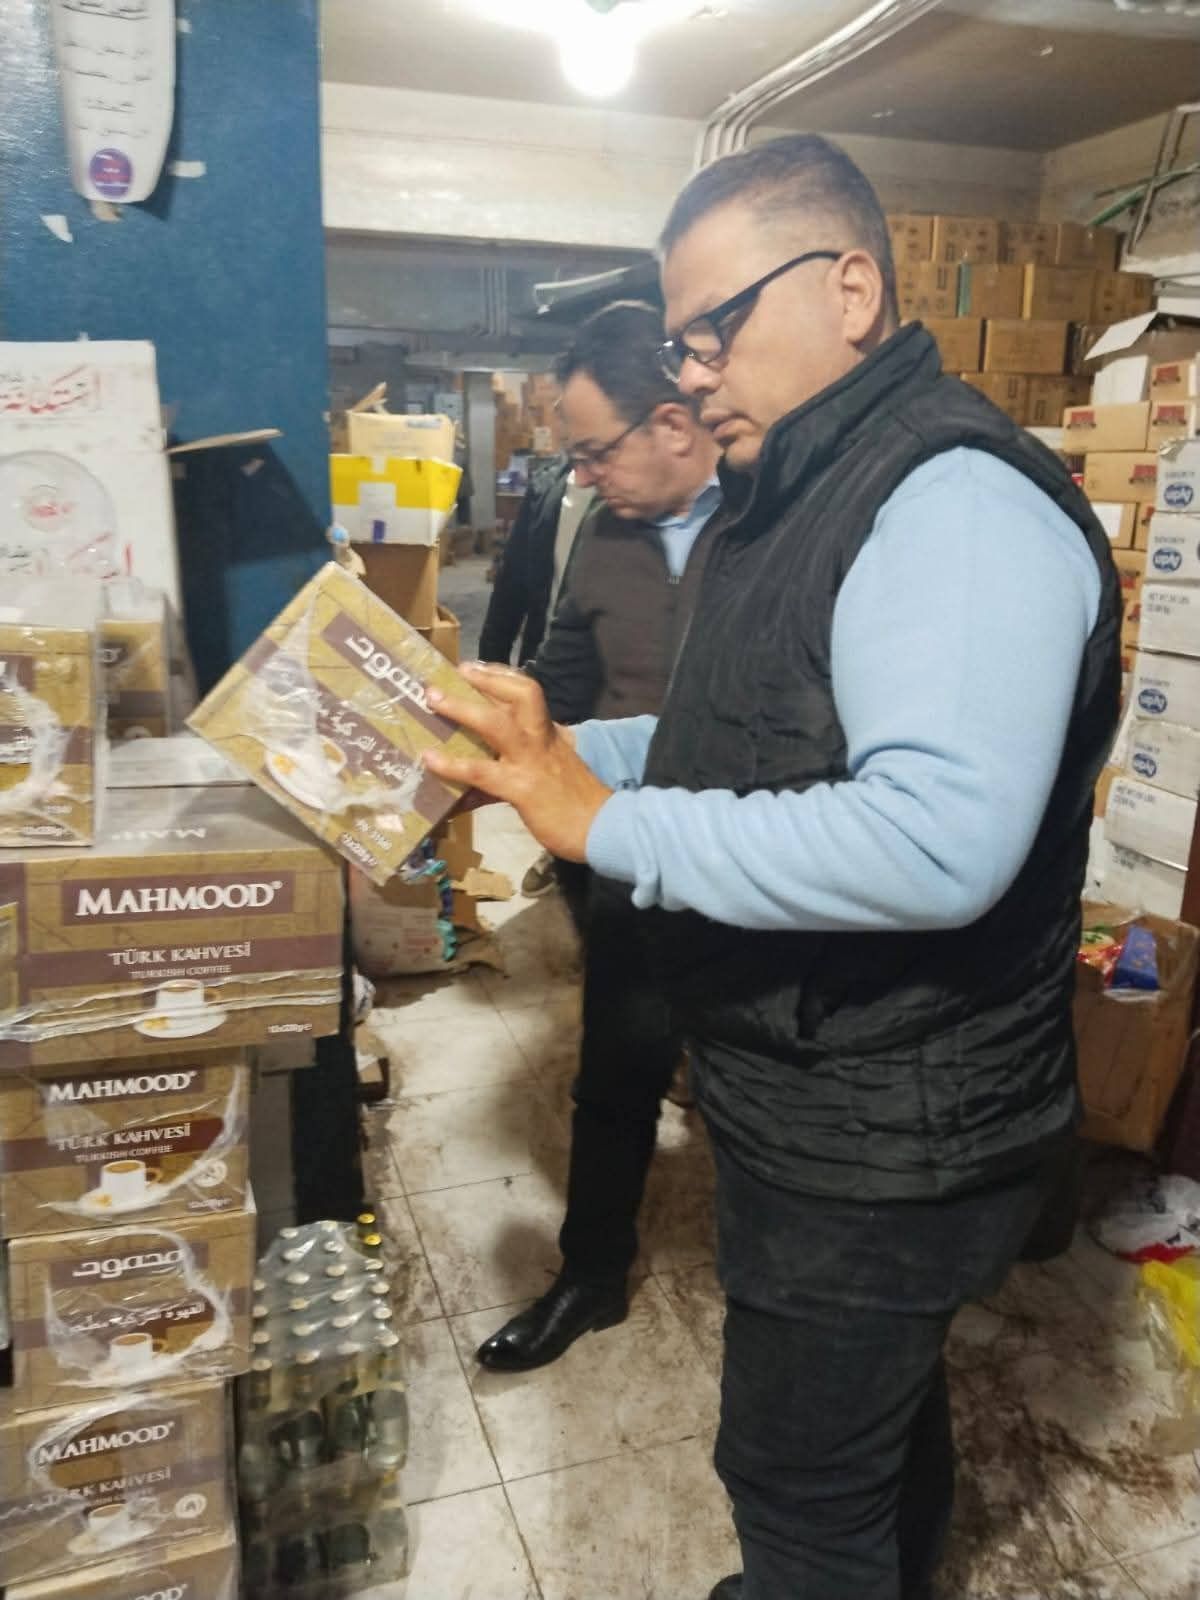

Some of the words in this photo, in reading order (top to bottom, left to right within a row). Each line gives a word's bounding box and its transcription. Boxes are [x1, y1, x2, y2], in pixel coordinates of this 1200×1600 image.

[344, 634, 433, 714] حمود
[75, 882, 275, 916] MAHMOOD
[107, 947, 166, 966] TÜRK
[170, 941, 251, 962] KAHVESİ
[49, 1073, 191, 1102] MAHMOOD
[113, 1122, 191, 1145] KAHVESİ
[38, 1423, 171, 1465] MAHMOOD
